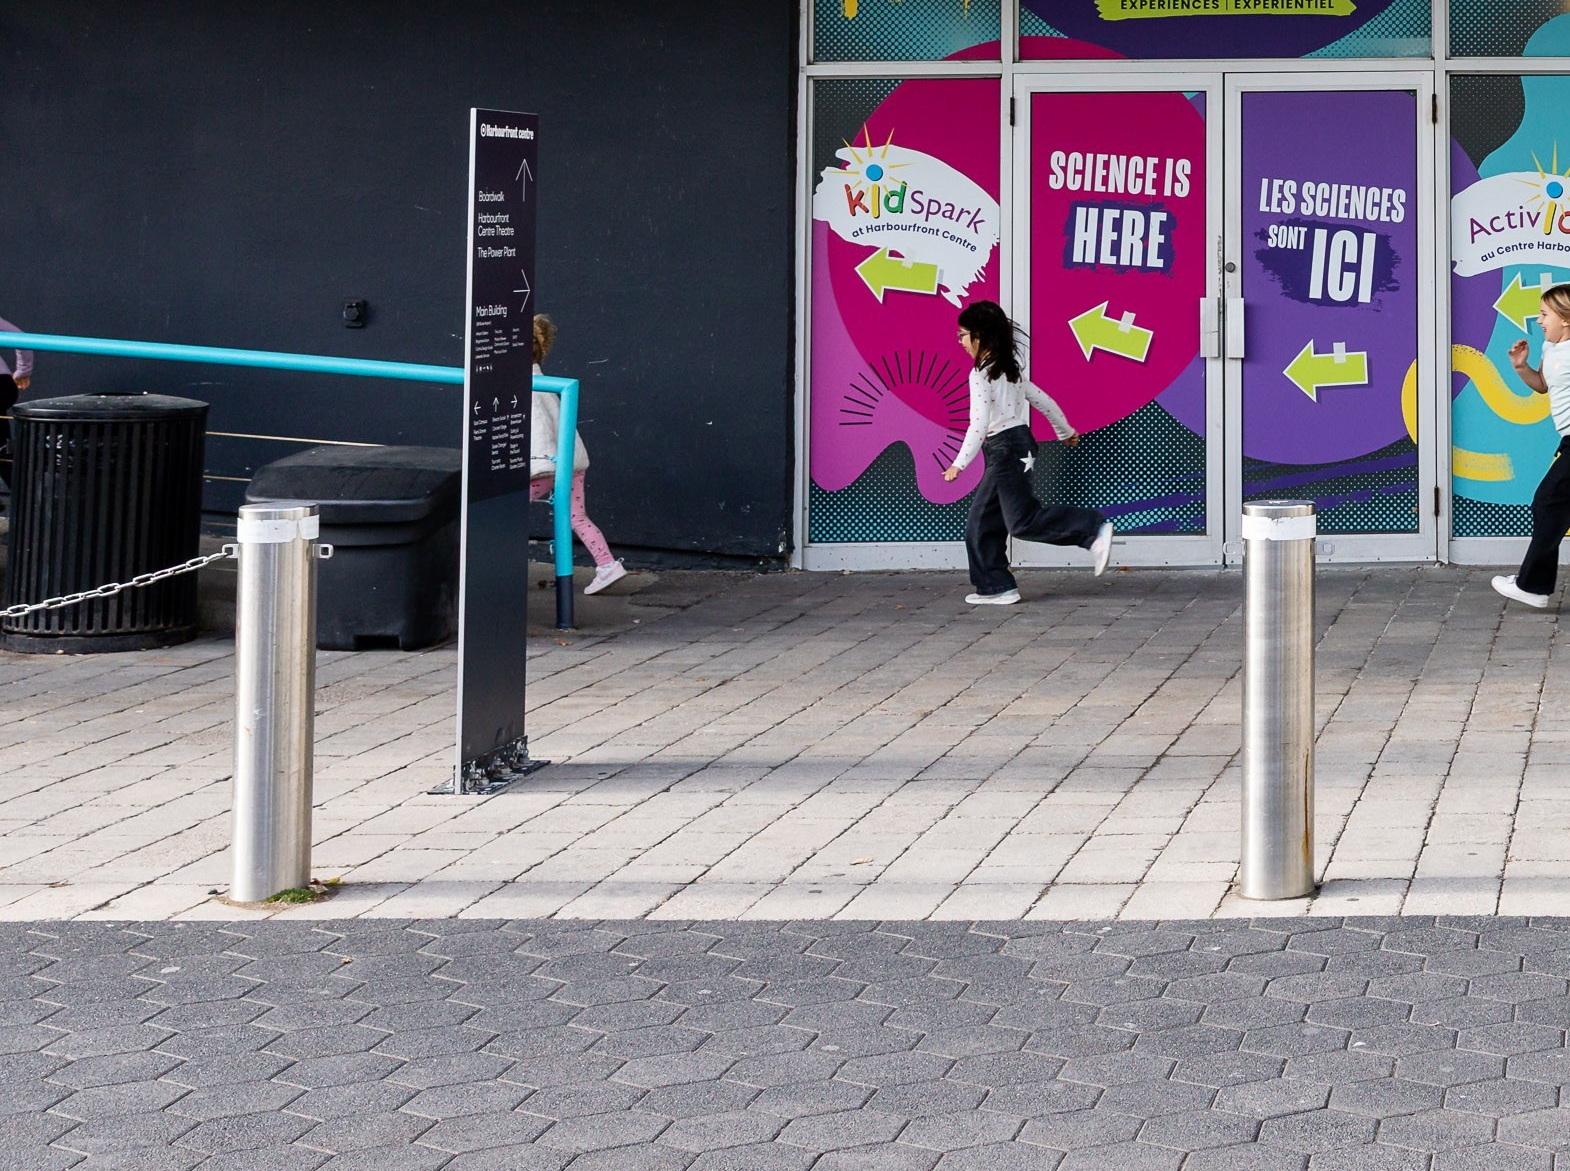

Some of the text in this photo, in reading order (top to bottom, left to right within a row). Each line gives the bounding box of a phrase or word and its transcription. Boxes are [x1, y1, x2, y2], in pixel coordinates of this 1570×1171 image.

[1048, 150, 1192, 198] SCIENCE IS
[478, 190, 505, 202] Boardwalk
[1259, 178, 1407, 223] LES SCIENCES
[478, 212, 510, 224] Harbourfront
[477, 224, 515, 237] Centre Theatre
[852, 222, 978, 252] at Harbourfront Centre
[1072, 206, 1168, 268] HERE
[1267, 224, 1308, 250] SONT
[477, 245, 517, 258] The Power Plant
[1480, 251, 1496, 262] au
[1496, 242, 1535, 255] Centre
[1308, 228, 1377, 304] ICI
[475, 304, 508, 318] Main Building
